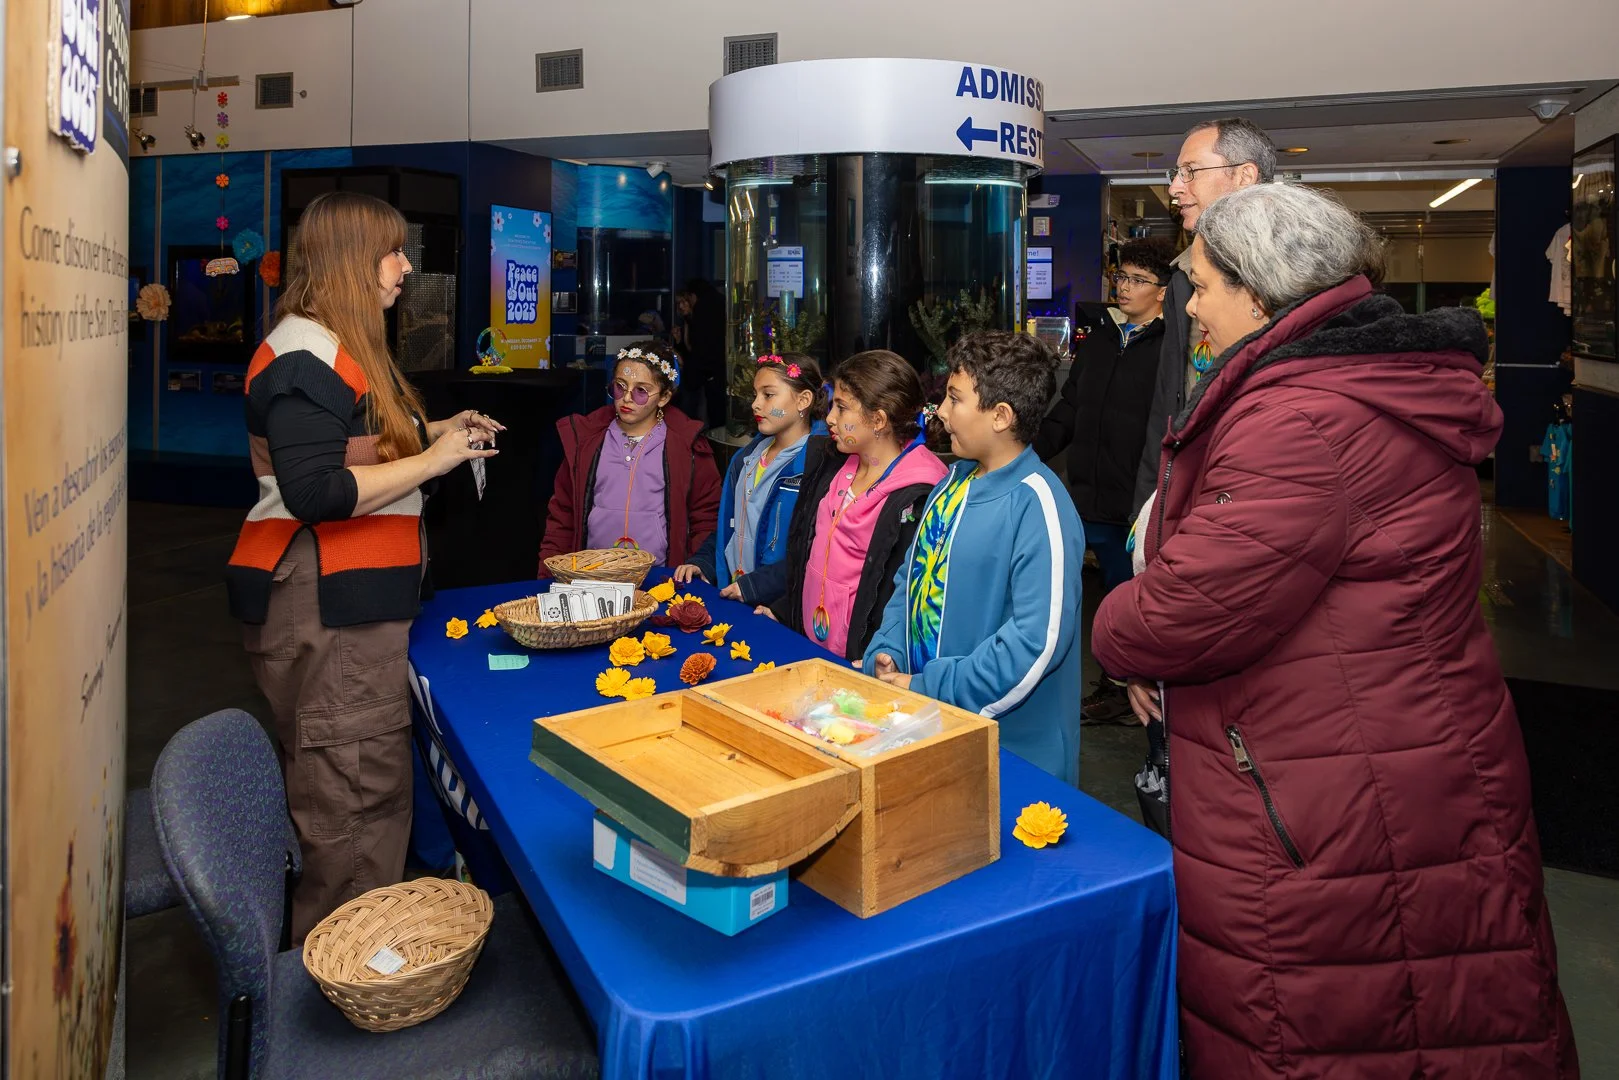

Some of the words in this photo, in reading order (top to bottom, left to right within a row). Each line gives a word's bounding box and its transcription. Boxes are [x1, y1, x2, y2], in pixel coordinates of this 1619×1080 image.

[61, 44, 97, 142] 2025
[19, 206, 61, 265] Come
[63, 217, 100, 272] discover
[101, 231, 111, 275] the
[508, 263, 537, 283] Peace
[20, 290, 65, 361] history
[67, 294, 79, 342] of
[80, 293, 94, 341] the
[95, 298, 107, 339] San
[507, 302, 536, 322] 2025
[518, 283, 537, 301] Out
[24, 487, 50, 539] Ven
[52, 486, 60, 519] a
[61, 446, 99, 510] descubrir
[25, 586, 34, 644] y
[37, 560, 49, 612] la
[50, 524, 86, 595] historia
[86, 508, 96, 552] de
